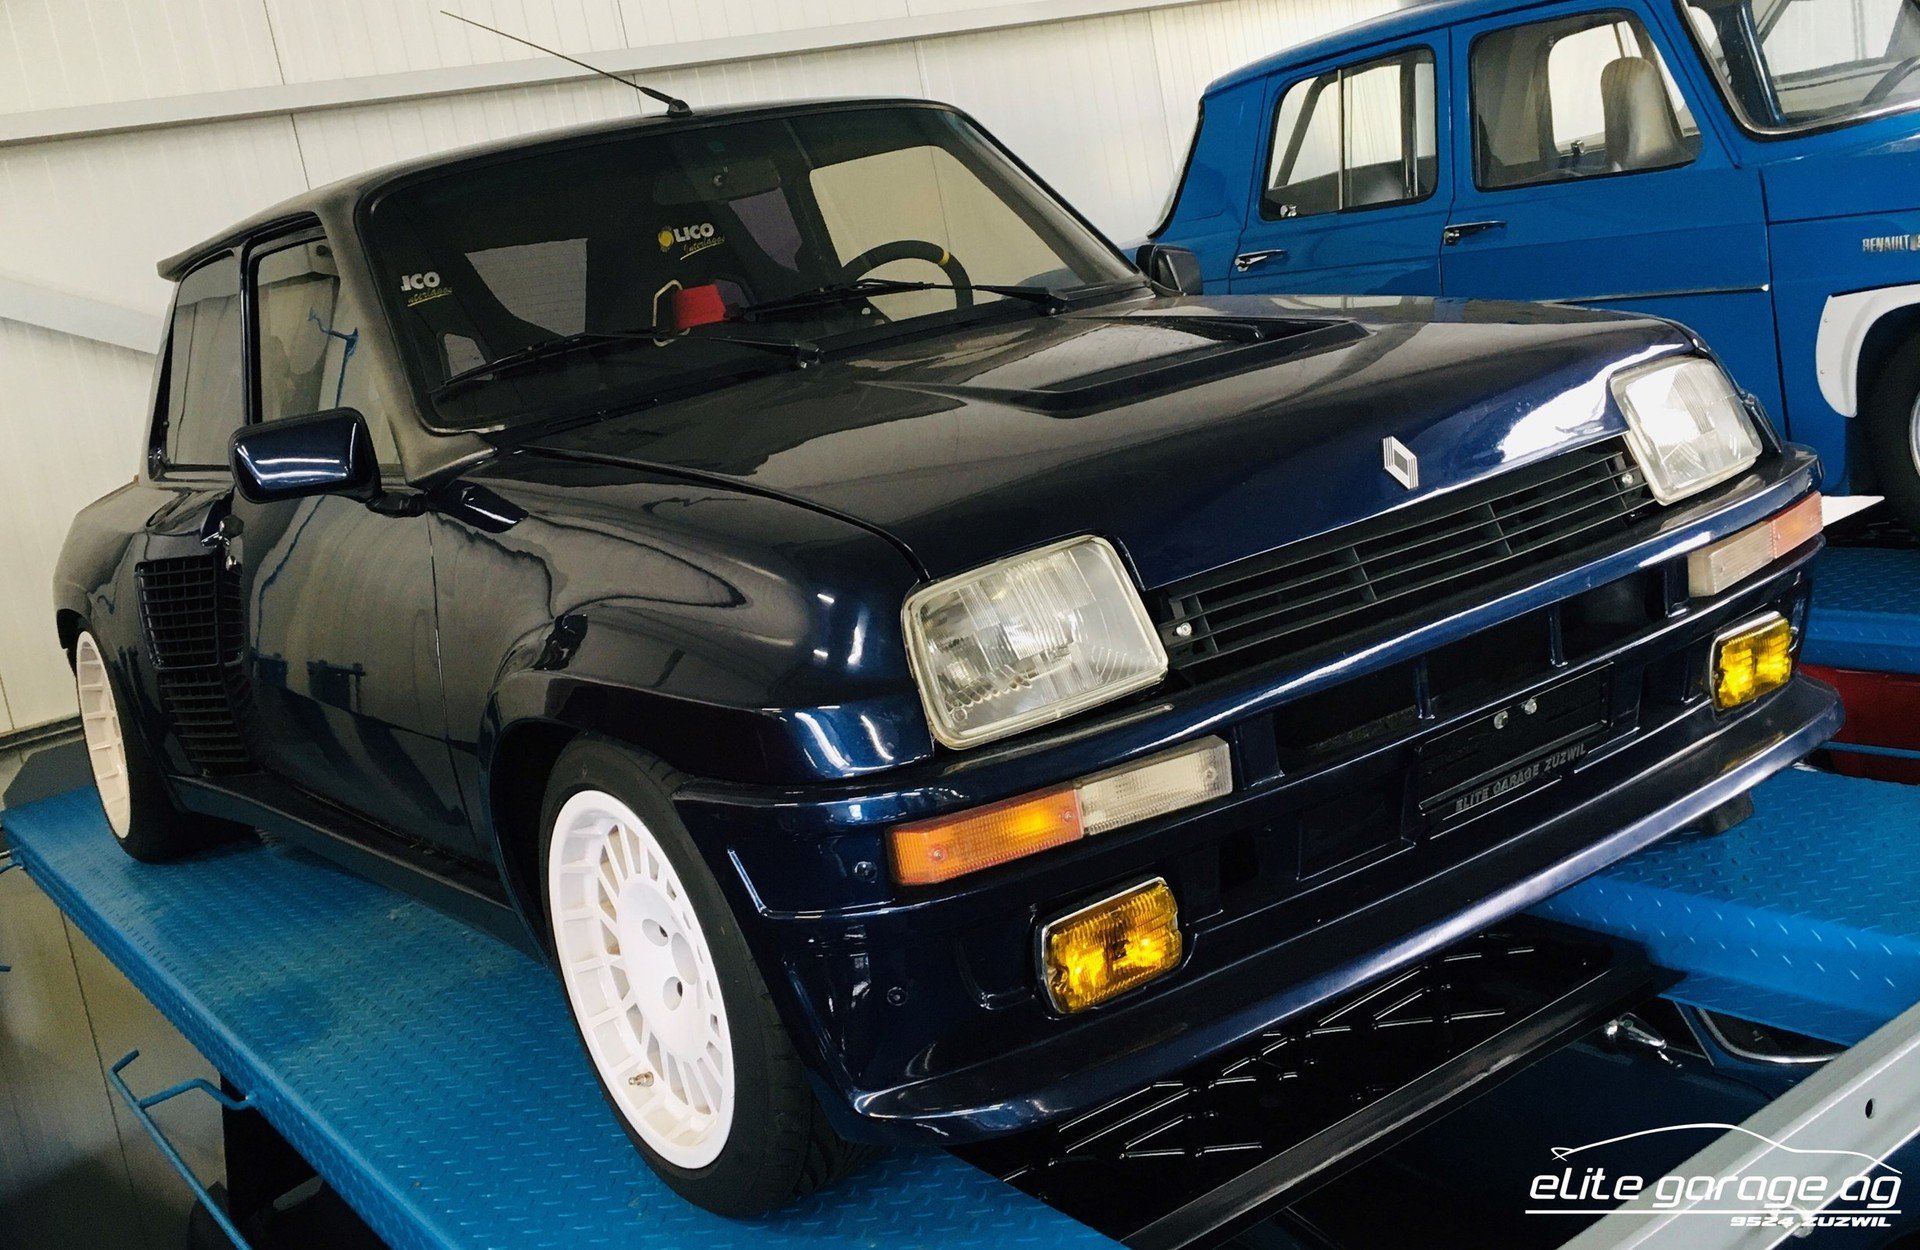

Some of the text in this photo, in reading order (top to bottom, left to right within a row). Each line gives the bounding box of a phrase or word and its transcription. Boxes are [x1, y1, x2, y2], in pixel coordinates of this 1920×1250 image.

[673, 222, 715, 243] LICO
[1862, 234, 1910, 252] RENAULT
[1455, 743, 1588, 813] ELITE GARAGE ZUZWIL
